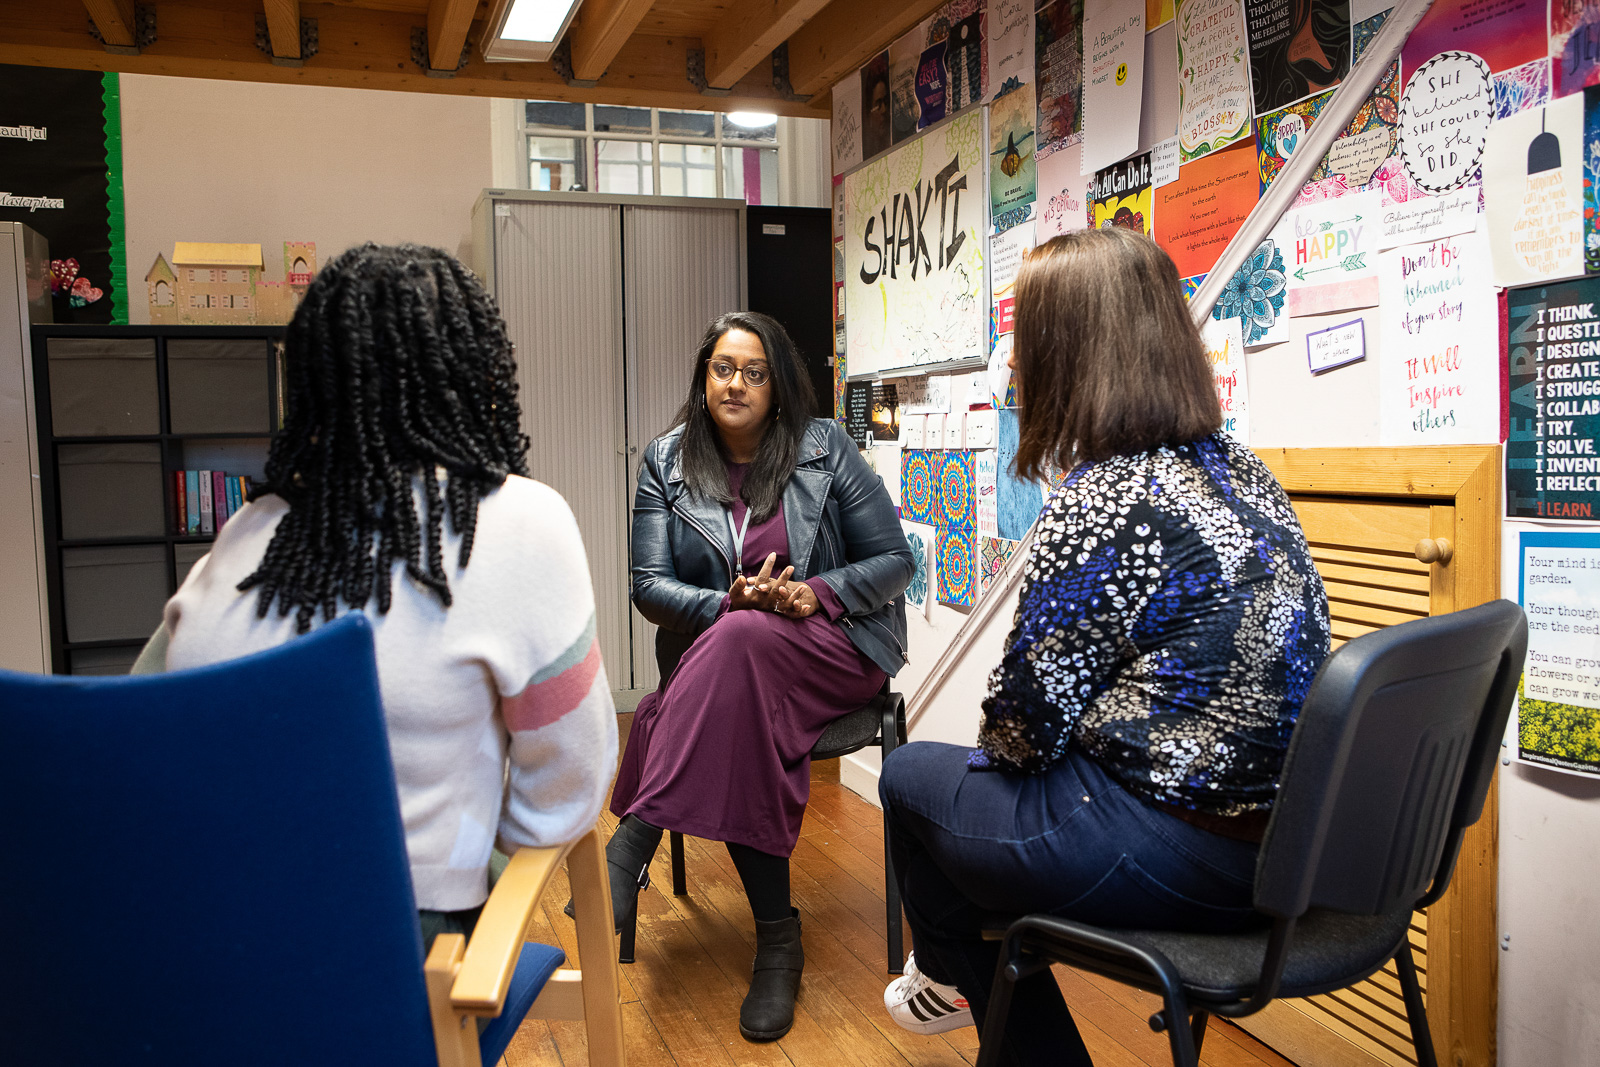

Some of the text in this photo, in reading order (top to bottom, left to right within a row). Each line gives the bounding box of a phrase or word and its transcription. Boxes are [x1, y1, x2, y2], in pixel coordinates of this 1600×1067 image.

[1190, 4, 1235, 37] GRATEFUL
[1250, 6, 1290, 30] THAT MAKE
[1093, 36, 1100, 51] A
[1129, 14, 1141, 27] DAY
[1209, 23, 1236, 43] PEOPLE
[1251, 18, 1291, 41] ME FEEL FREE
[1192, 79, 1208, 94] THEY
[1208, 72, 1221, 88] ARE
[1428, 70, 1460, 94] SHE
[1412, 84, 1481, 118] believed
[1444, 128, 1473, 149] she
[1102, 171, 1112, 198] All
[1112, 166, 1126, 194] Can
[1127, 161, 1140, 190] Do
[1164, 195, 1175, 204] Even
[1175, 190, 1184, 198] after
[1190, 185, 1198, 193] this
[1215, 176, 1226, 187] Sun
[1226, 173, 1239, 181] never
[1238, 170, 1249, 178] says
[1205, 193, 1216, 202] earth
[860, 151, 967, 285] SHAKTI
[1383, 211, 1411, 224] Believe
[1421, 200, 1446, 221] yourself
[1446, 197, 1459, 210] and
[1460, 200, 1473, 212] you
[1168, 233, 1180, 243] Look
[1180, 230, 1189, 238] what
[1189, 227, 1207, 237] happens
[1207, 222, 1216, 231] with
[1218, 219, 1227, 227] love
[1227, 216, 1236, 224] like
[1294, 215, 1319, 239] be
[1384, 215, 1444, 236] will be unstoppable
[1514, 217, 1544, 231] darkest
[1190, 241, 1201, 252] lights
[1208, 235, 1221, 245] whole
[1221, 233, 1229, 243] sky
[1296, 225, 1364, 265] HAPPY
[1441, 237, 1462, 268] Be
[1515, 235, 1565, 254] remembers
[1524, 246, 1572, 268] turn on the
[1404, 264, 1465, 307] Ashamed
[1402, 300, 1463, 334] of your story
[1537, 303, 1598, 324] I THINK.
[1536, 327, 1545, 342] I
[1204, 339, 1229, 369] ood
[1536, 340, 1600, 361] I DESIGN
[1404, 345, 1463, 380] It Will
[1215, 369, 1238, 397] ings
[1536, 366, 1544, 381] I
[1406, 383, 1467, 409] Inspire
[1536, 384, 1543, 399] I
[1412, 408, 1456, 433] others
[1536, 403, 1543, 418] I
[1536, 420, 1577, 437] I TRY.
[1536, 439, 1597, 456] I SOLVE.
[1536, 459, 1543, 474] I
[1536, 476, 1543, 491] I
[1537, 501, 1594, 517] I LEARN.
[1529, 556, 1587, 569] Your mind
[1529, 572, 1572, 585] garden.
[1528, 602, 1555, 615] Your
[1528, 621, 1548, 630] are
[1550, 621, 1570, 632] the
[1529, 649, 1572, 665] You can
[1529, 665, 1590, 683] flowers or
[1529, 683, 1580, 698] can grow
